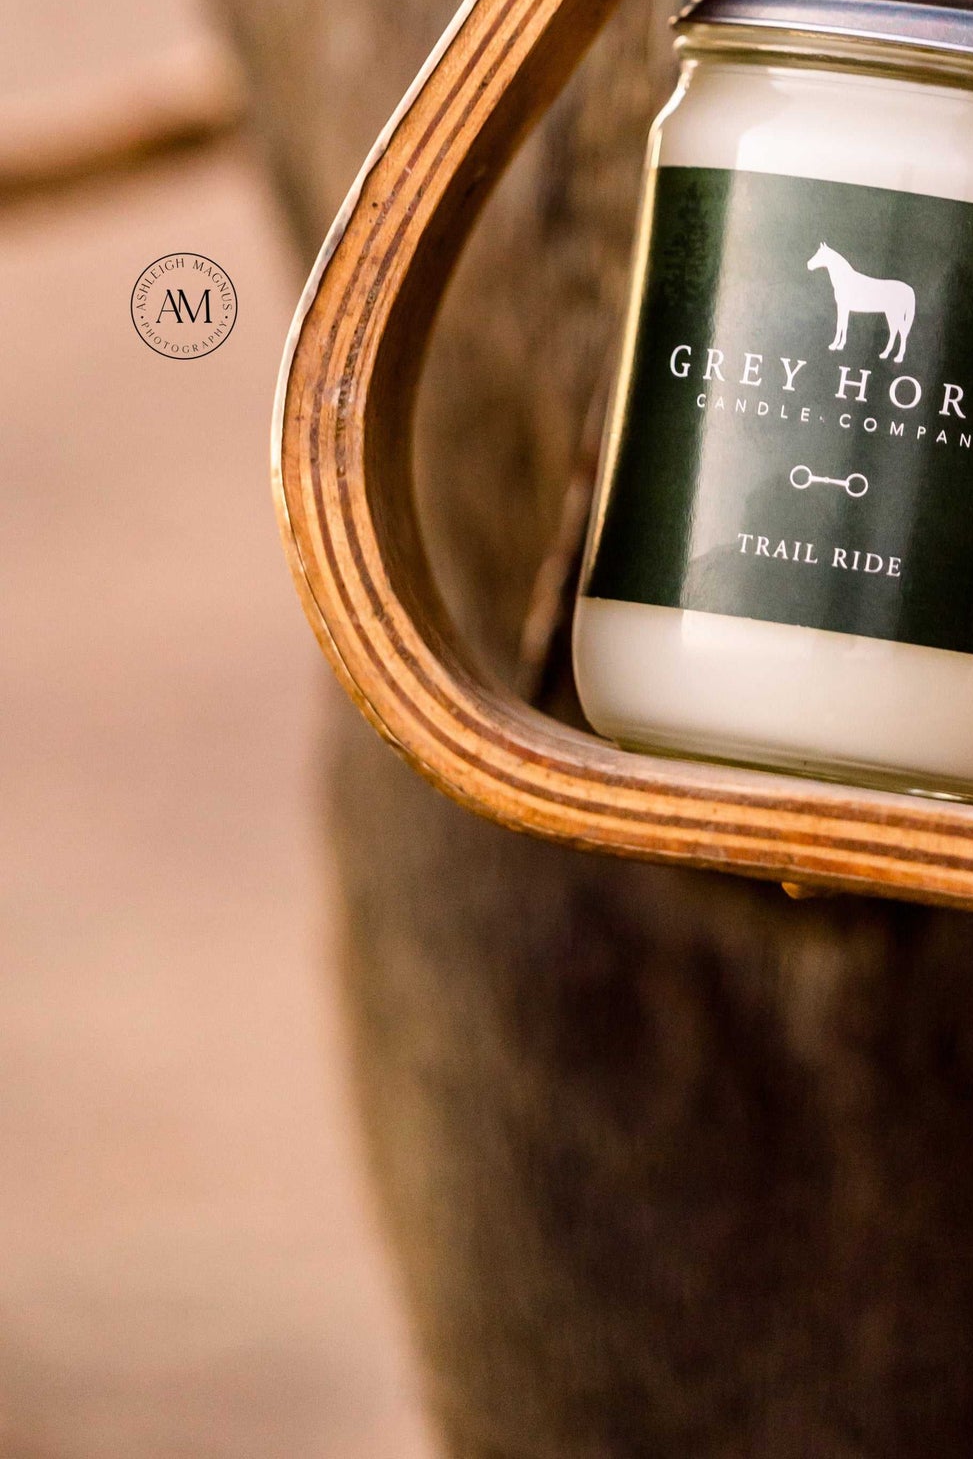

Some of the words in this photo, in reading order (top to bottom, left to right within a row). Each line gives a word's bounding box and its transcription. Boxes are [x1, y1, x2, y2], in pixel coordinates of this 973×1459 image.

[669, 344, 807, 392] GREY
[696, 393, 811, 422] CANDLE
[737, 533, 818, 564] TRAIL
[831, 547, 902, 577] RIDE
